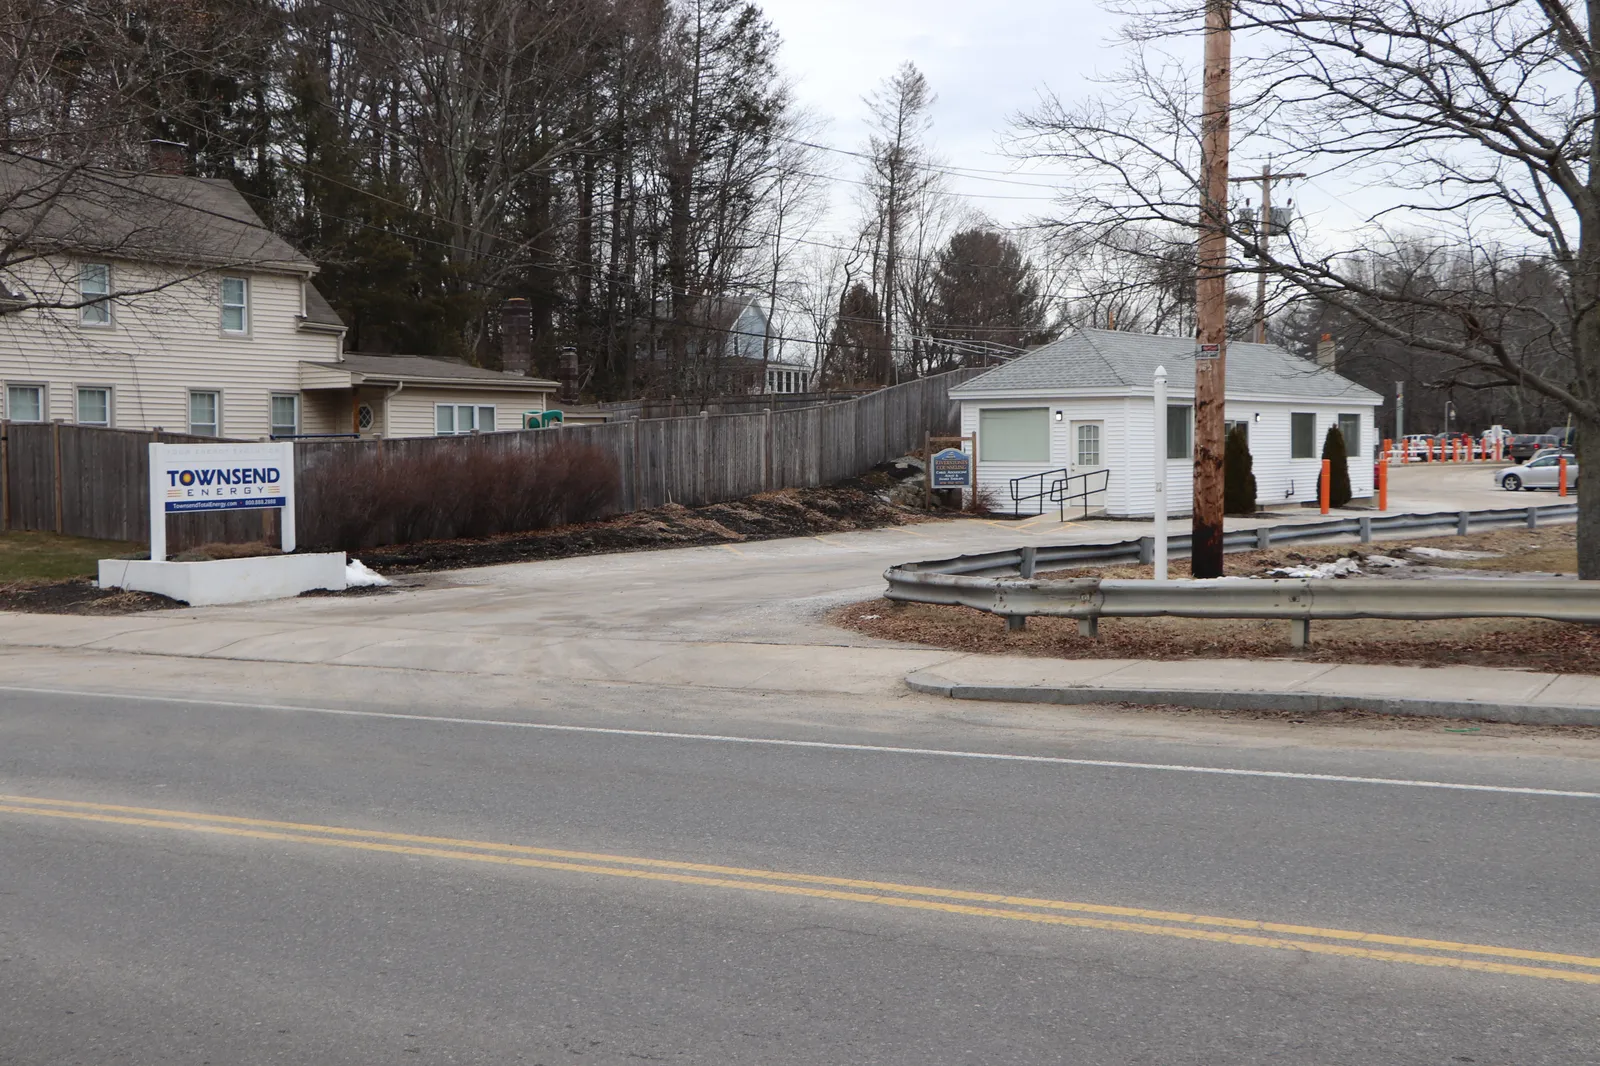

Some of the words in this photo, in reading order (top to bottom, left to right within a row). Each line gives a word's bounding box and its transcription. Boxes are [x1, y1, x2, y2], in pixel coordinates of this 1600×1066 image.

[166, 468, 280, 487] TOWNSEND
[187, 486, 264, 497] ENERGY
[172, 501, 238, 509] TownsendTotalEnergy.com
